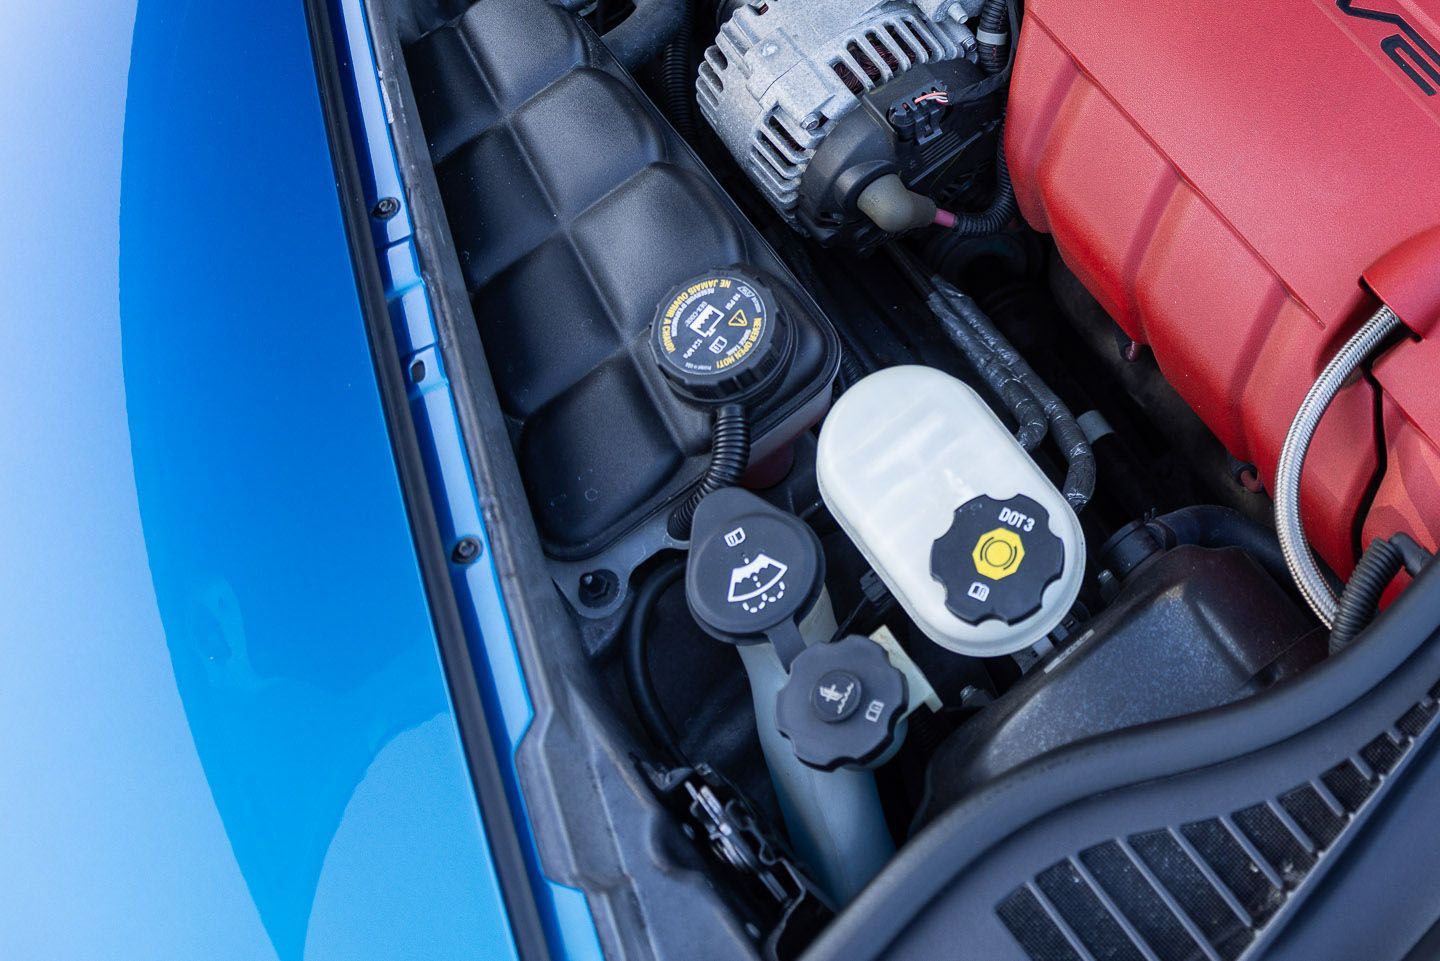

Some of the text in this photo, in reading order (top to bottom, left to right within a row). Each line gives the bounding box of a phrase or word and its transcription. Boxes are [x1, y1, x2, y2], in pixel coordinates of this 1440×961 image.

[687, 279, 719, 296] JAMAIS
[719, 279, 732, 289] NE
[665, 291, 689, 318] OUVRIR
[748, 317, 763, 342] NEVER
[734, 341, 753, 360] OPEN
[716, 355, 736, 369] HOT!
[998, 506, 1036, 532] DOT 3
